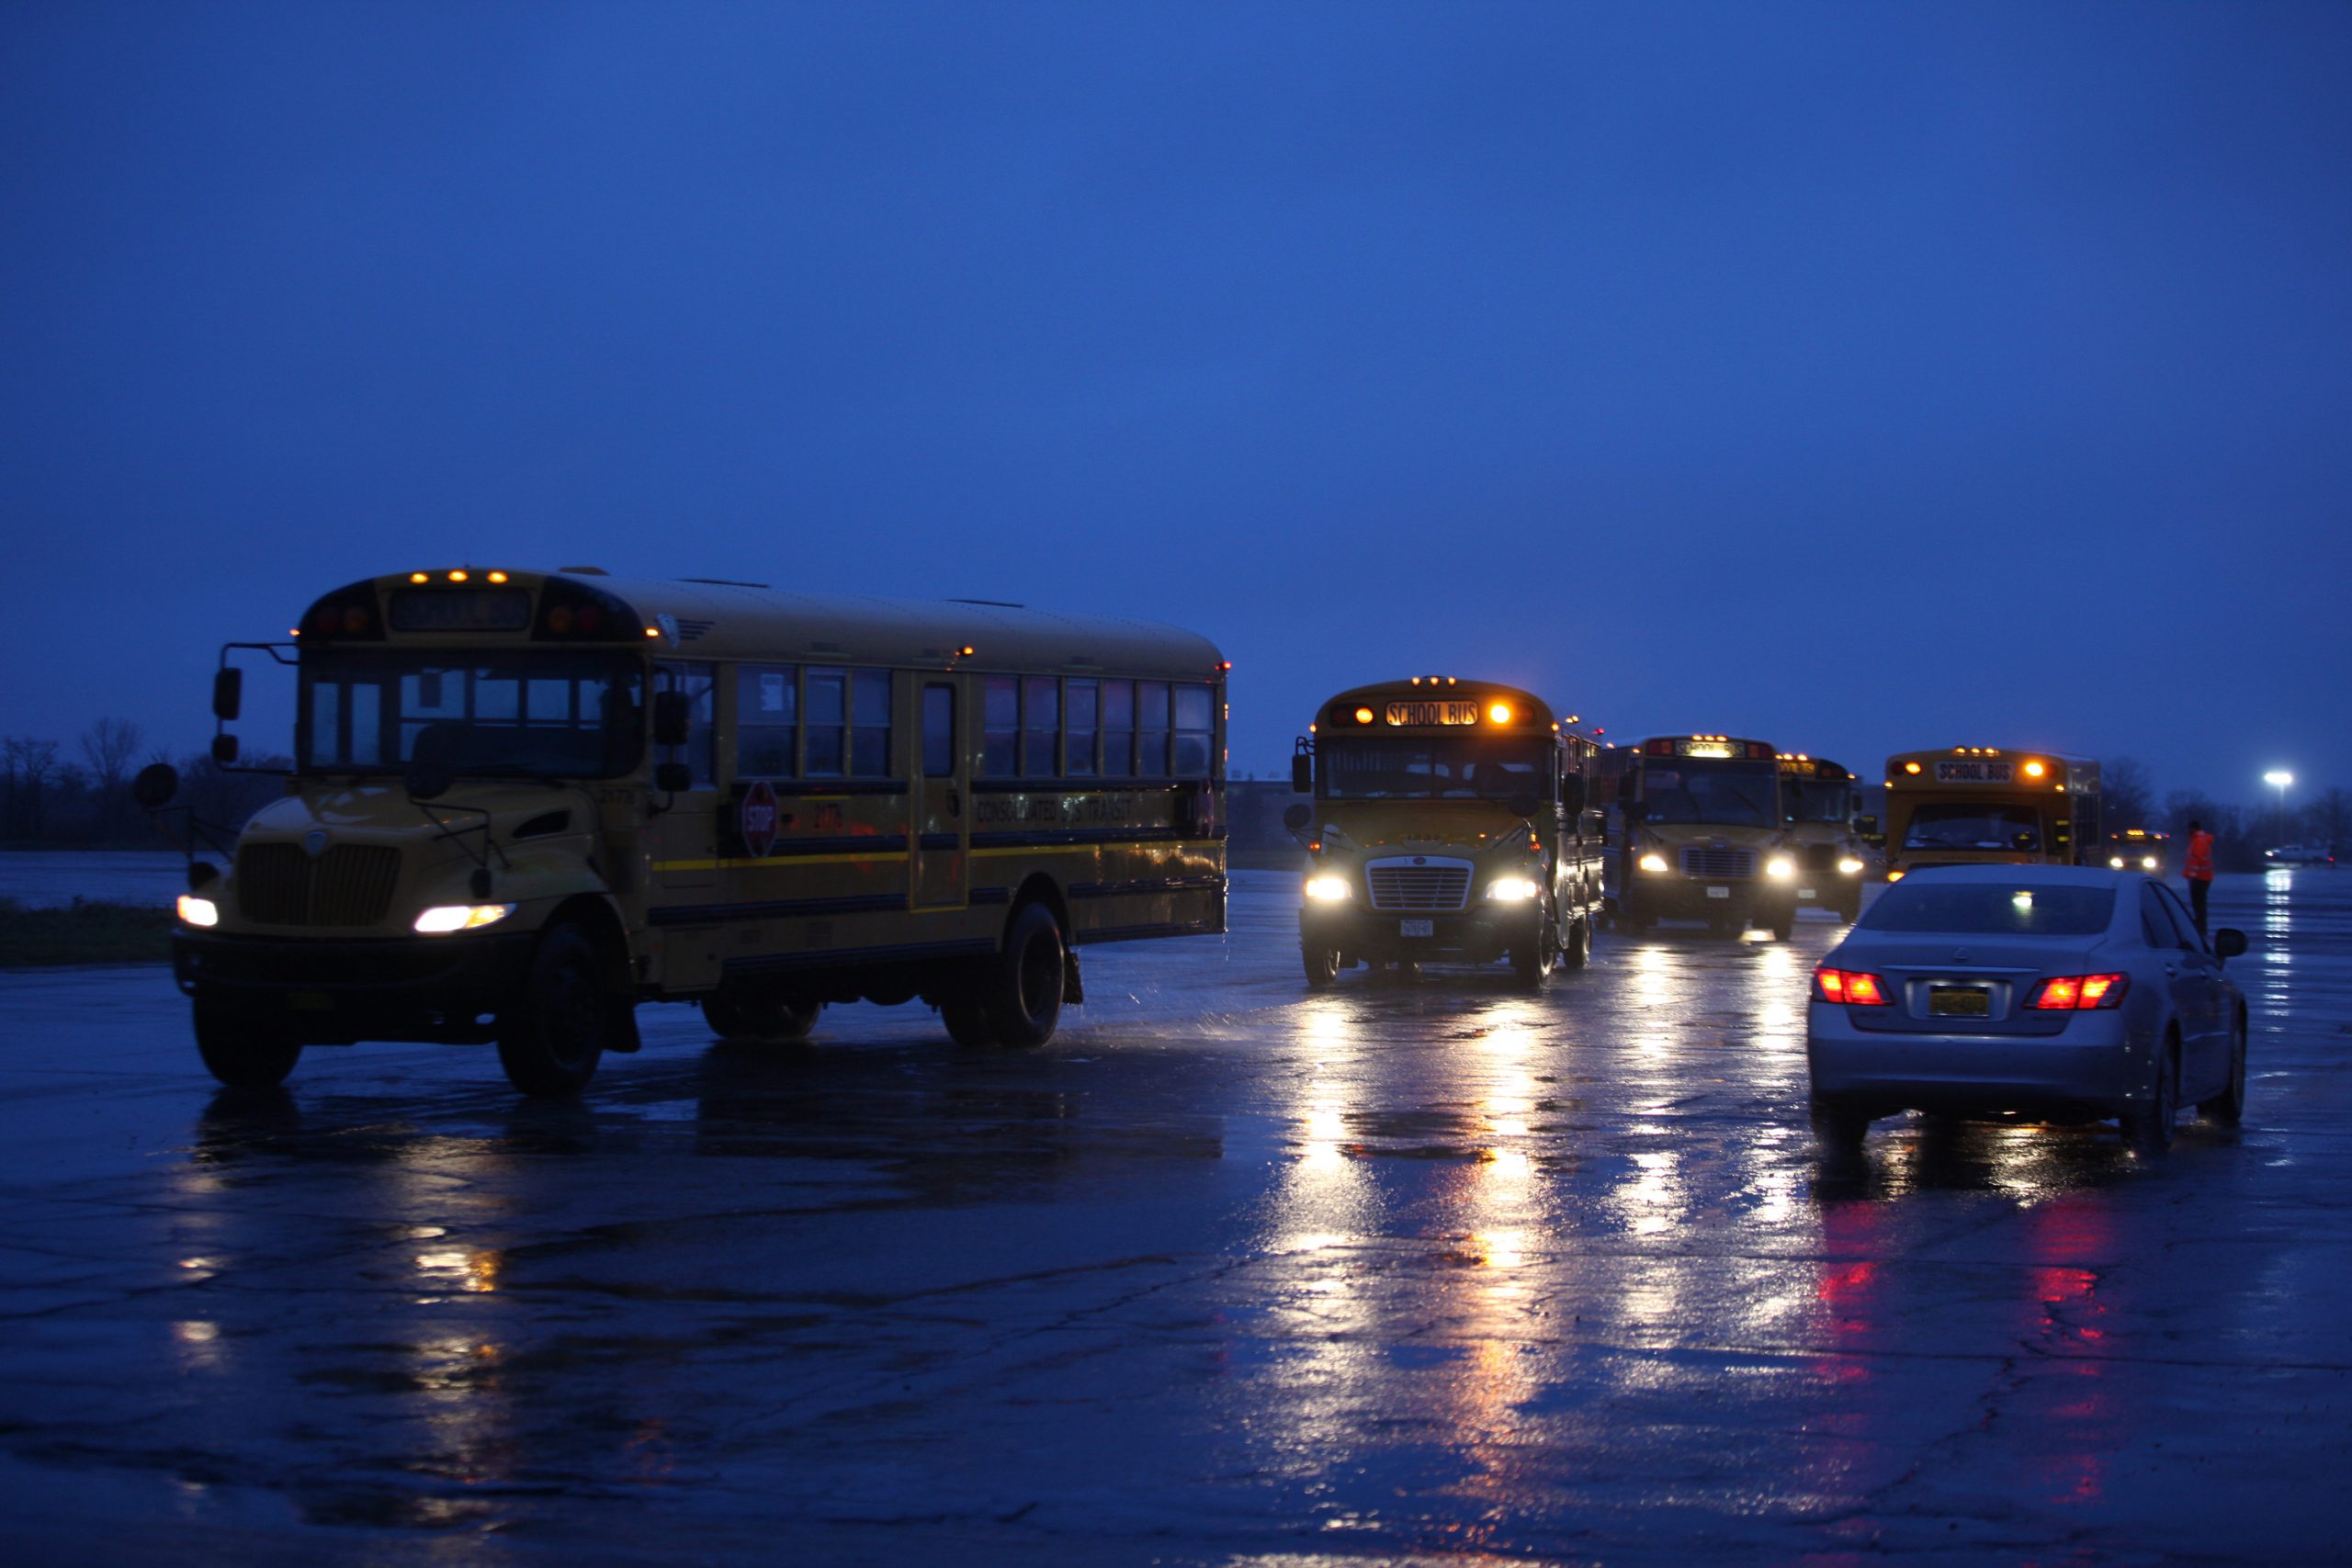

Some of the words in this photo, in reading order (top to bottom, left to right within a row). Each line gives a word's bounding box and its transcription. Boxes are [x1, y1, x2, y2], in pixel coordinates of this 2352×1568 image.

[1388, 703, 1443, 725] SCHOOL
[1448, 703, 1476, 725] BUS
[1678, 742, 1716, 757] SCHOO
[1939, 763, 1984, 780] SCHOOL
[1987, 763, 2010, 780] BUS
[749, 806, 773, 832] STOP
[977, 800, 1057, 823] CONSOATED
